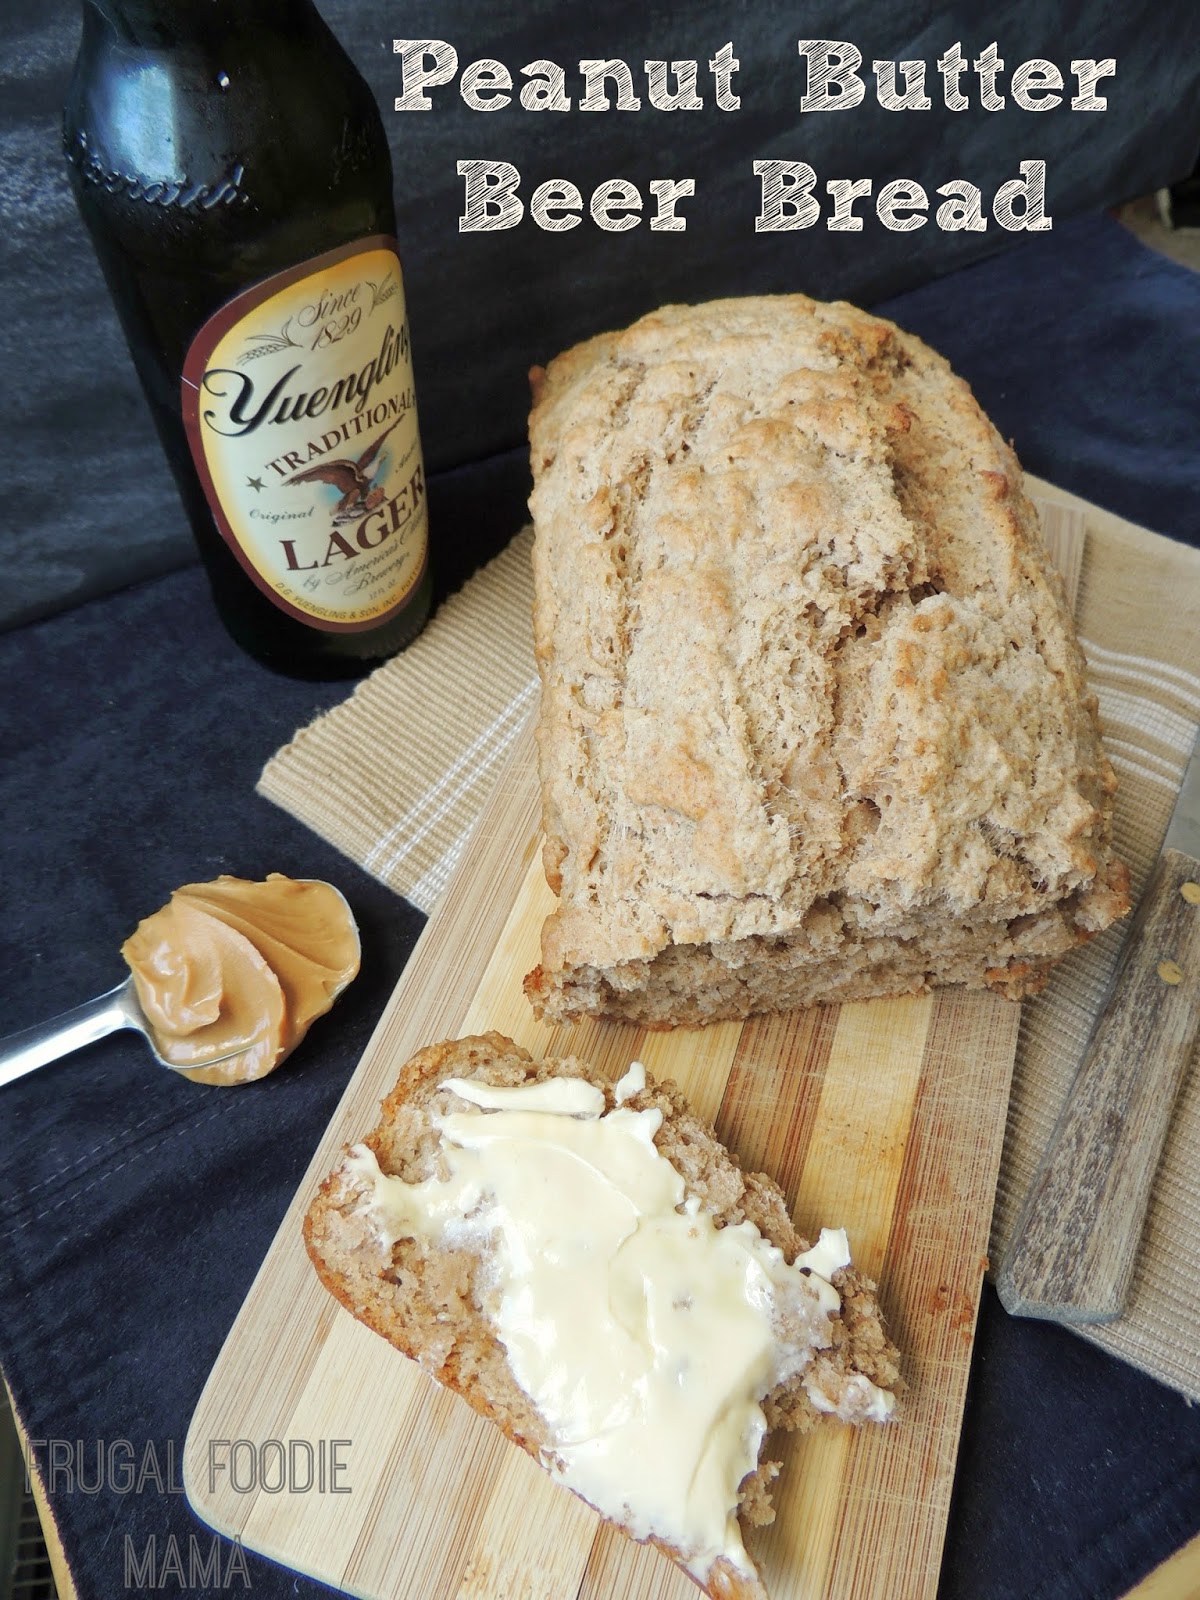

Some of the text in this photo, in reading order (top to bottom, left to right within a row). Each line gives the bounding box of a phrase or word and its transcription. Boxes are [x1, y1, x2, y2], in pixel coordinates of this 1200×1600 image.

[298, 283, 361, 327] Since
[311, 306, 362, 351] 1829
[265, 387, 411, 477] TRADITIONAL
[249, 506, 315, 525] Original
